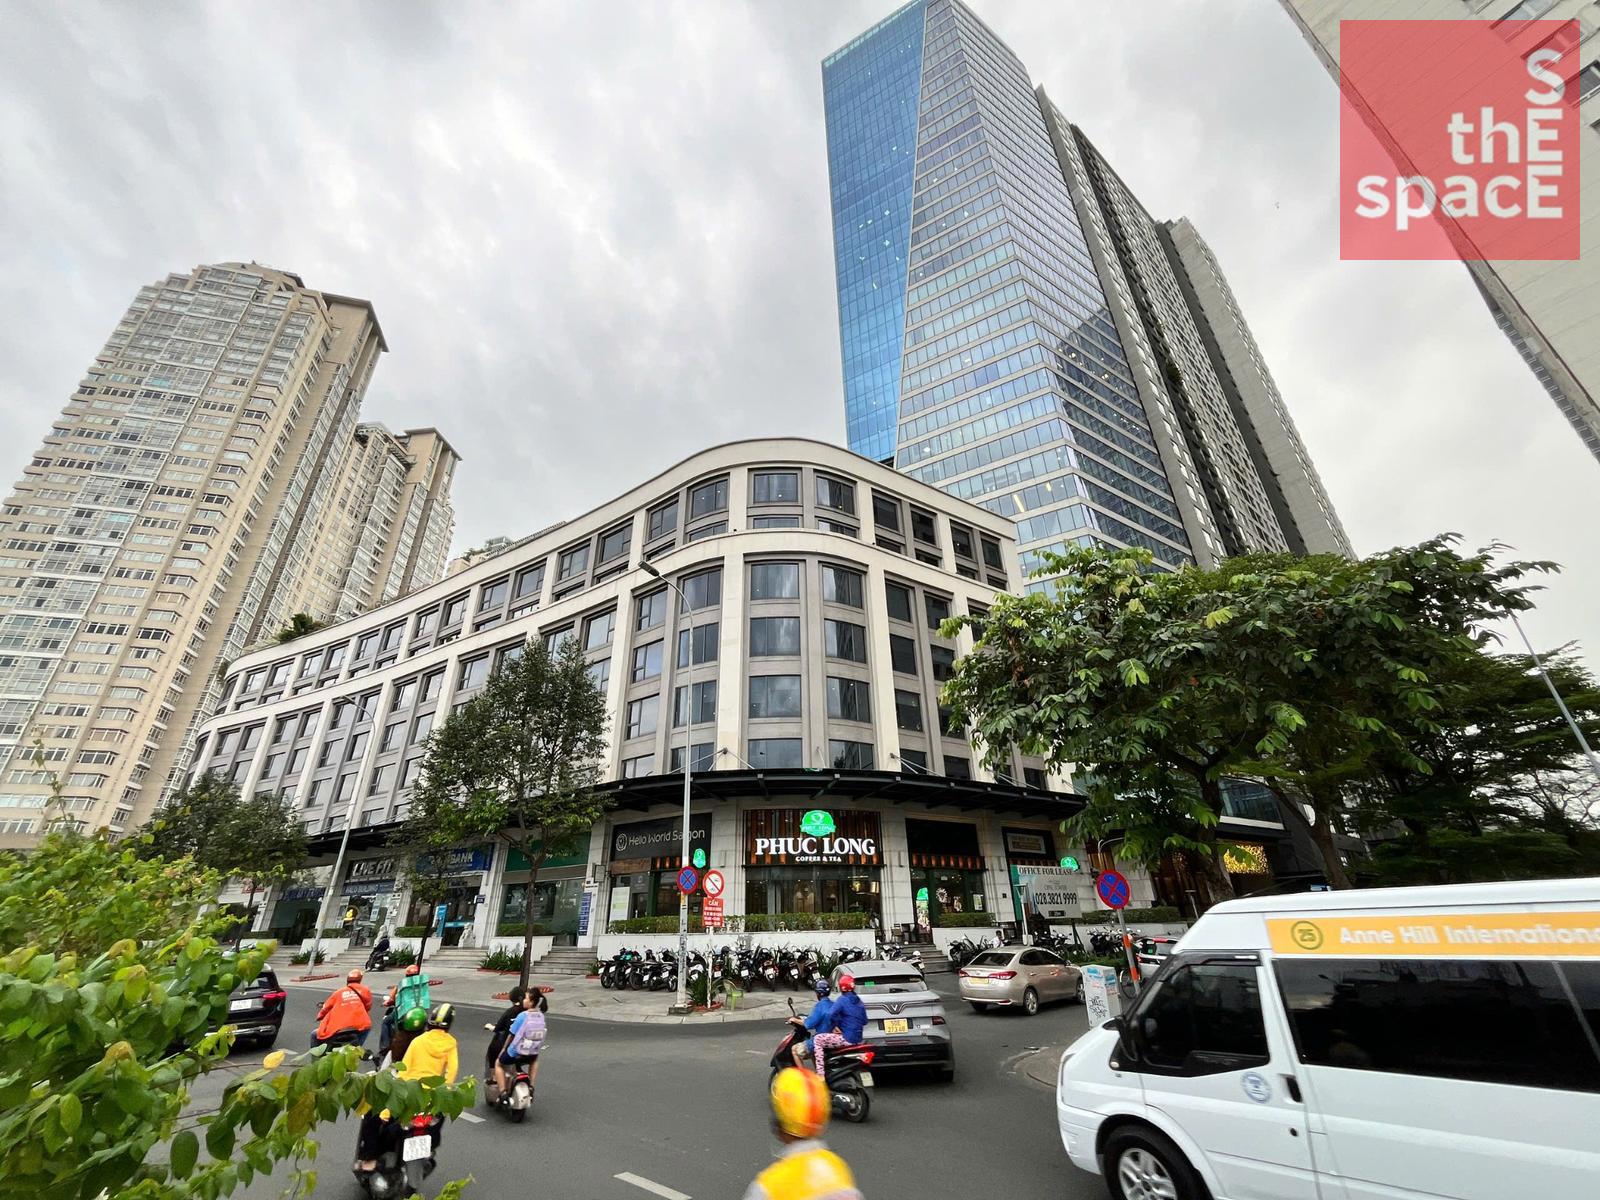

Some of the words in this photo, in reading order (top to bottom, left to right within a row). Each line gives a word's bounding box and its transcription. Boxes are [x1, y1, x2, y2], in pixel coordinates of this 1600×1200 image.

[628, 834, 647, 846] Hello
[648, 831, 671, 844] World
[672, 829, 705, 841] Sagon
[755, 837, 817, 855] PHUC
[822, 837, 876, 855] LONG
[1019, 866, 1041, 875] OFFICE
[1042, 867, 1055, 875] FOR
[1055, 867, 1073, 876] LEASE
[1063, 892, 1078, 905] 9999
[1297, 928, 1317, 942] 25
[1339, 926, 1395, 944] Anne
[1398, 925, 1438, 944] Hill
